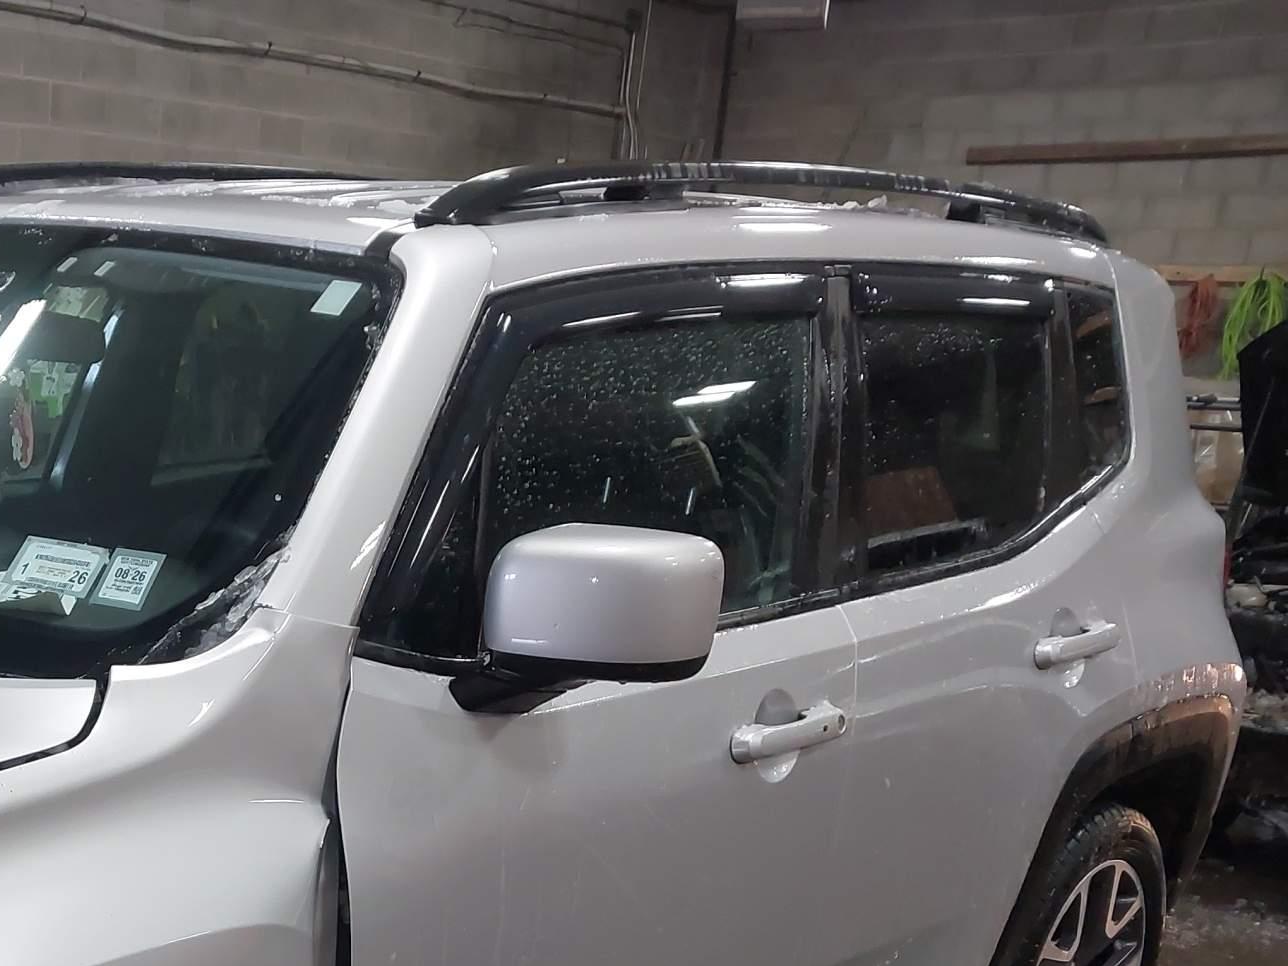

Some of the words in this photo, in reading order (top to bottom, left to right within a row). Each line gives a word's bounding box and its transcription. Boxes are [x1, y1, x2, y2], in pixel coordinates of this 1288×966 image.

[21, 562, 30, 575] 1
[68, 570, 88, 585] 26
[114, 567, 130, 579] 08
[131, 570, 147, 582] 26
